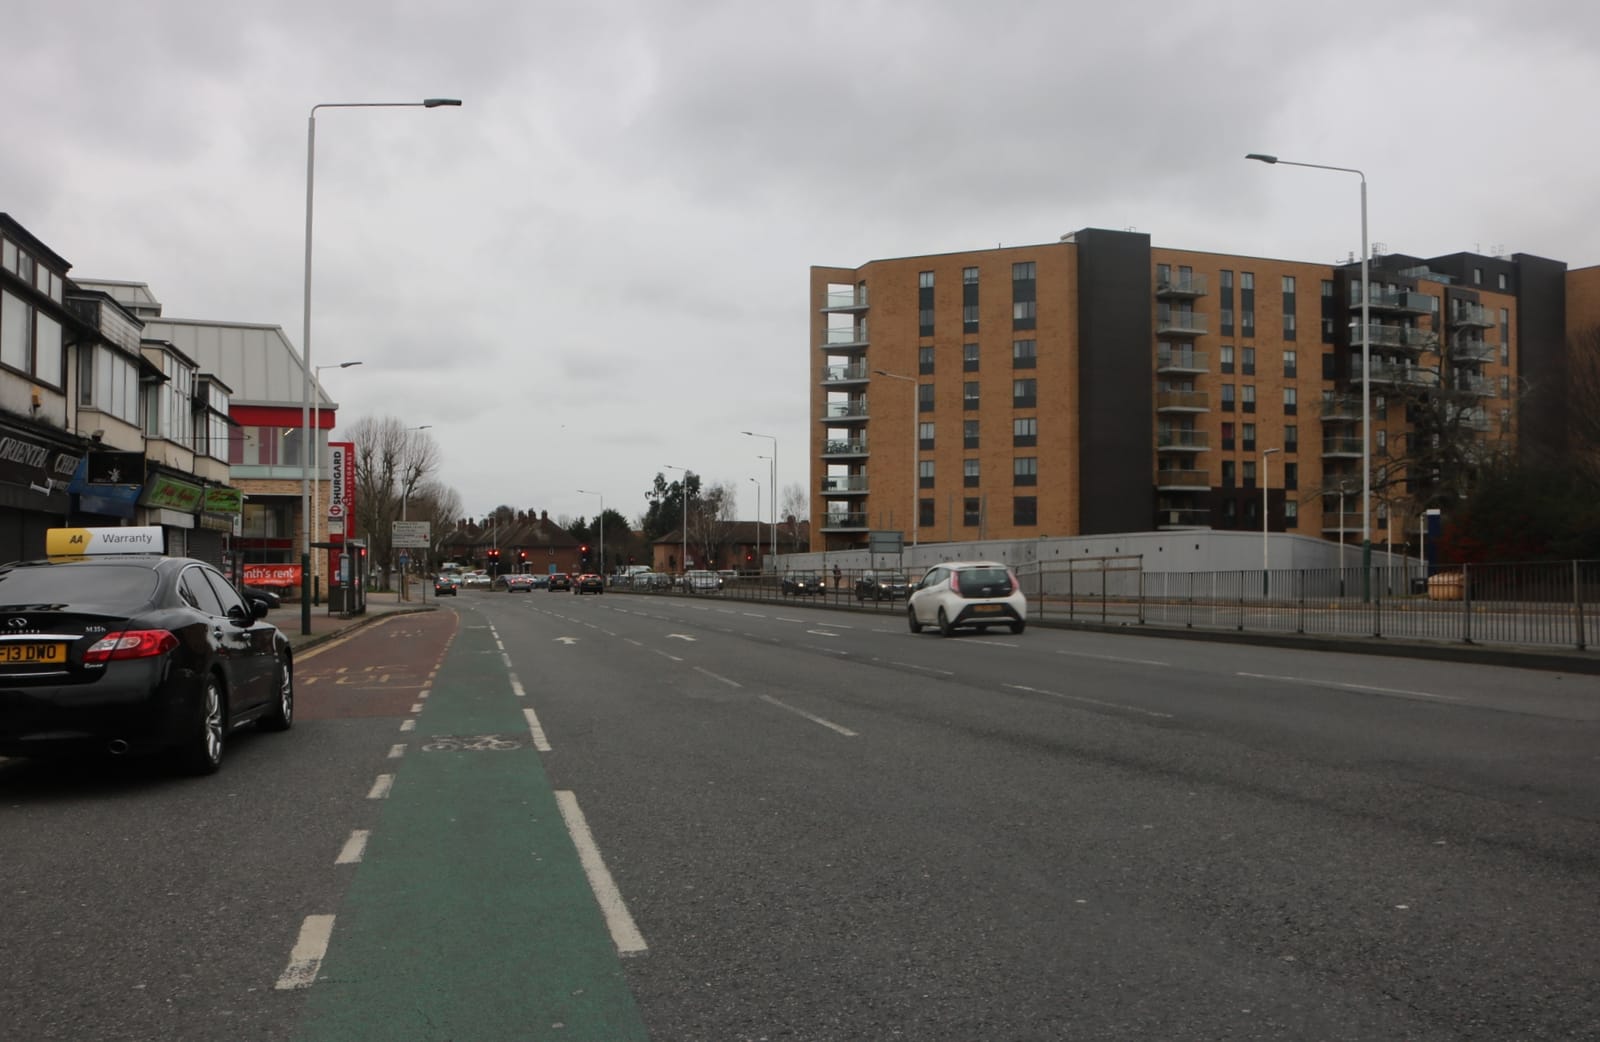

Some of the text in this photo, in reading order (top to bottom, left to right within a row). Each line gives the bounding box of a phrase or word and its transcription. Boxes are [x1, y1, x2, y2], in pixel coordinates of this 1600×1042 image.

[333, 451, 342, 505] SHURGARD
[69, 533, 153, 544] AA Warranty
[273, 568, 294, 578] rent
[26, 645, 57, 660] DWO
